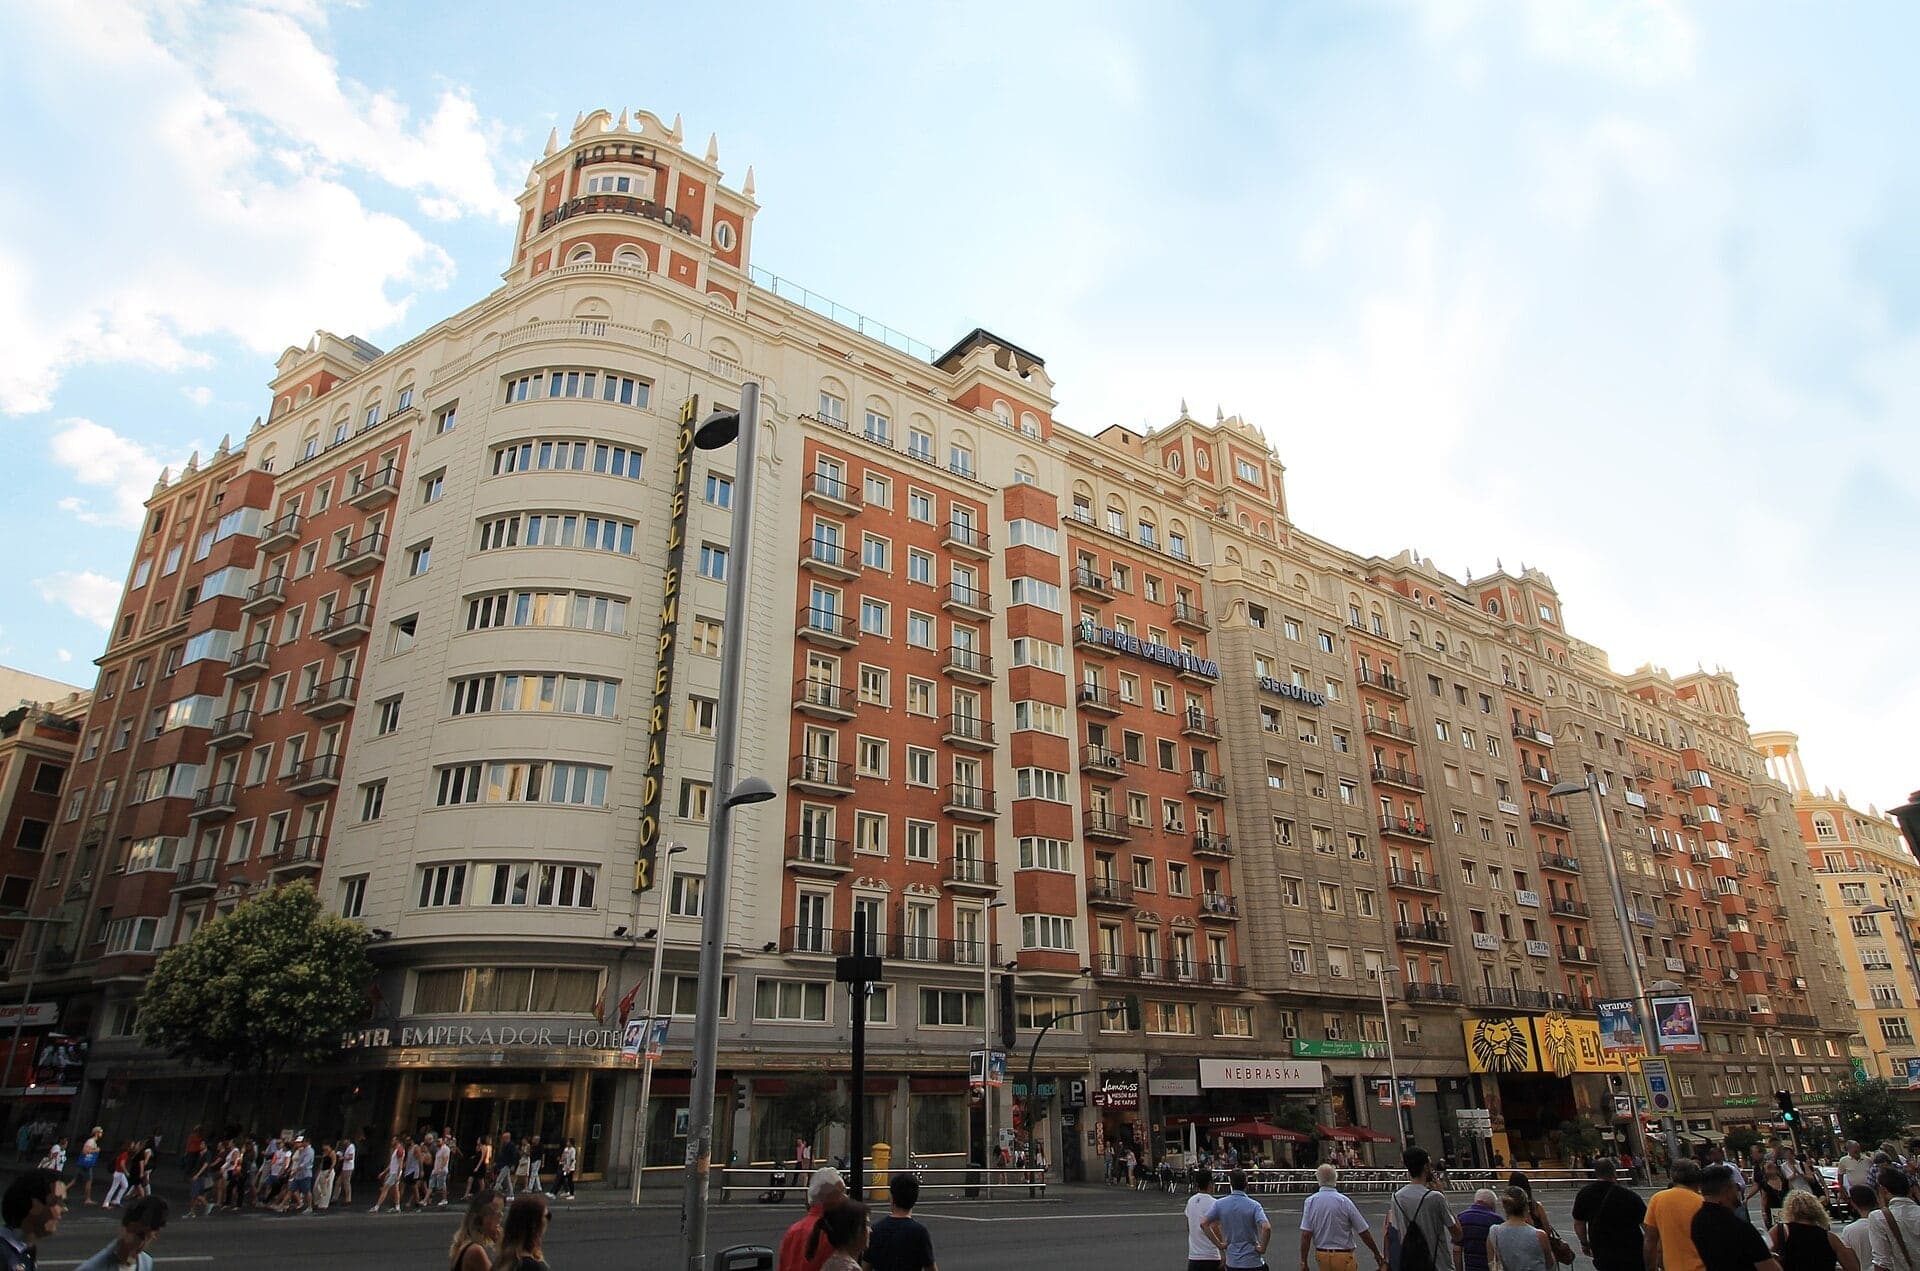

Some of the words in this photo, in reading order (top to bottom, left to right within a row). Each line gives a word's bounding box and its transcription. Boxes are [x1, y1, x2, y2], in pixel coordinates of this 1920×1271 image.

[575, 143, 664, 172] HOTEL
[540, 197, 692, 236] EMPERADOR
[669, 400, 693, 551] HOTEL
[1101, 626, 1221, 679] PREVENTIVA
[1261, 676, 1326, 708] SEGUROS
[635, 568, 677, 890] EMPERADOR
[1598, 1000, 1632, 1011] veranos
[401, 1026, 552, 1046] EMPERADOR
[1580, 1037, 1595, 1059] EL
[1225, 1068, 1300, 1080] NEBRASKA
[1071, 1081, 1083, 1101] P
